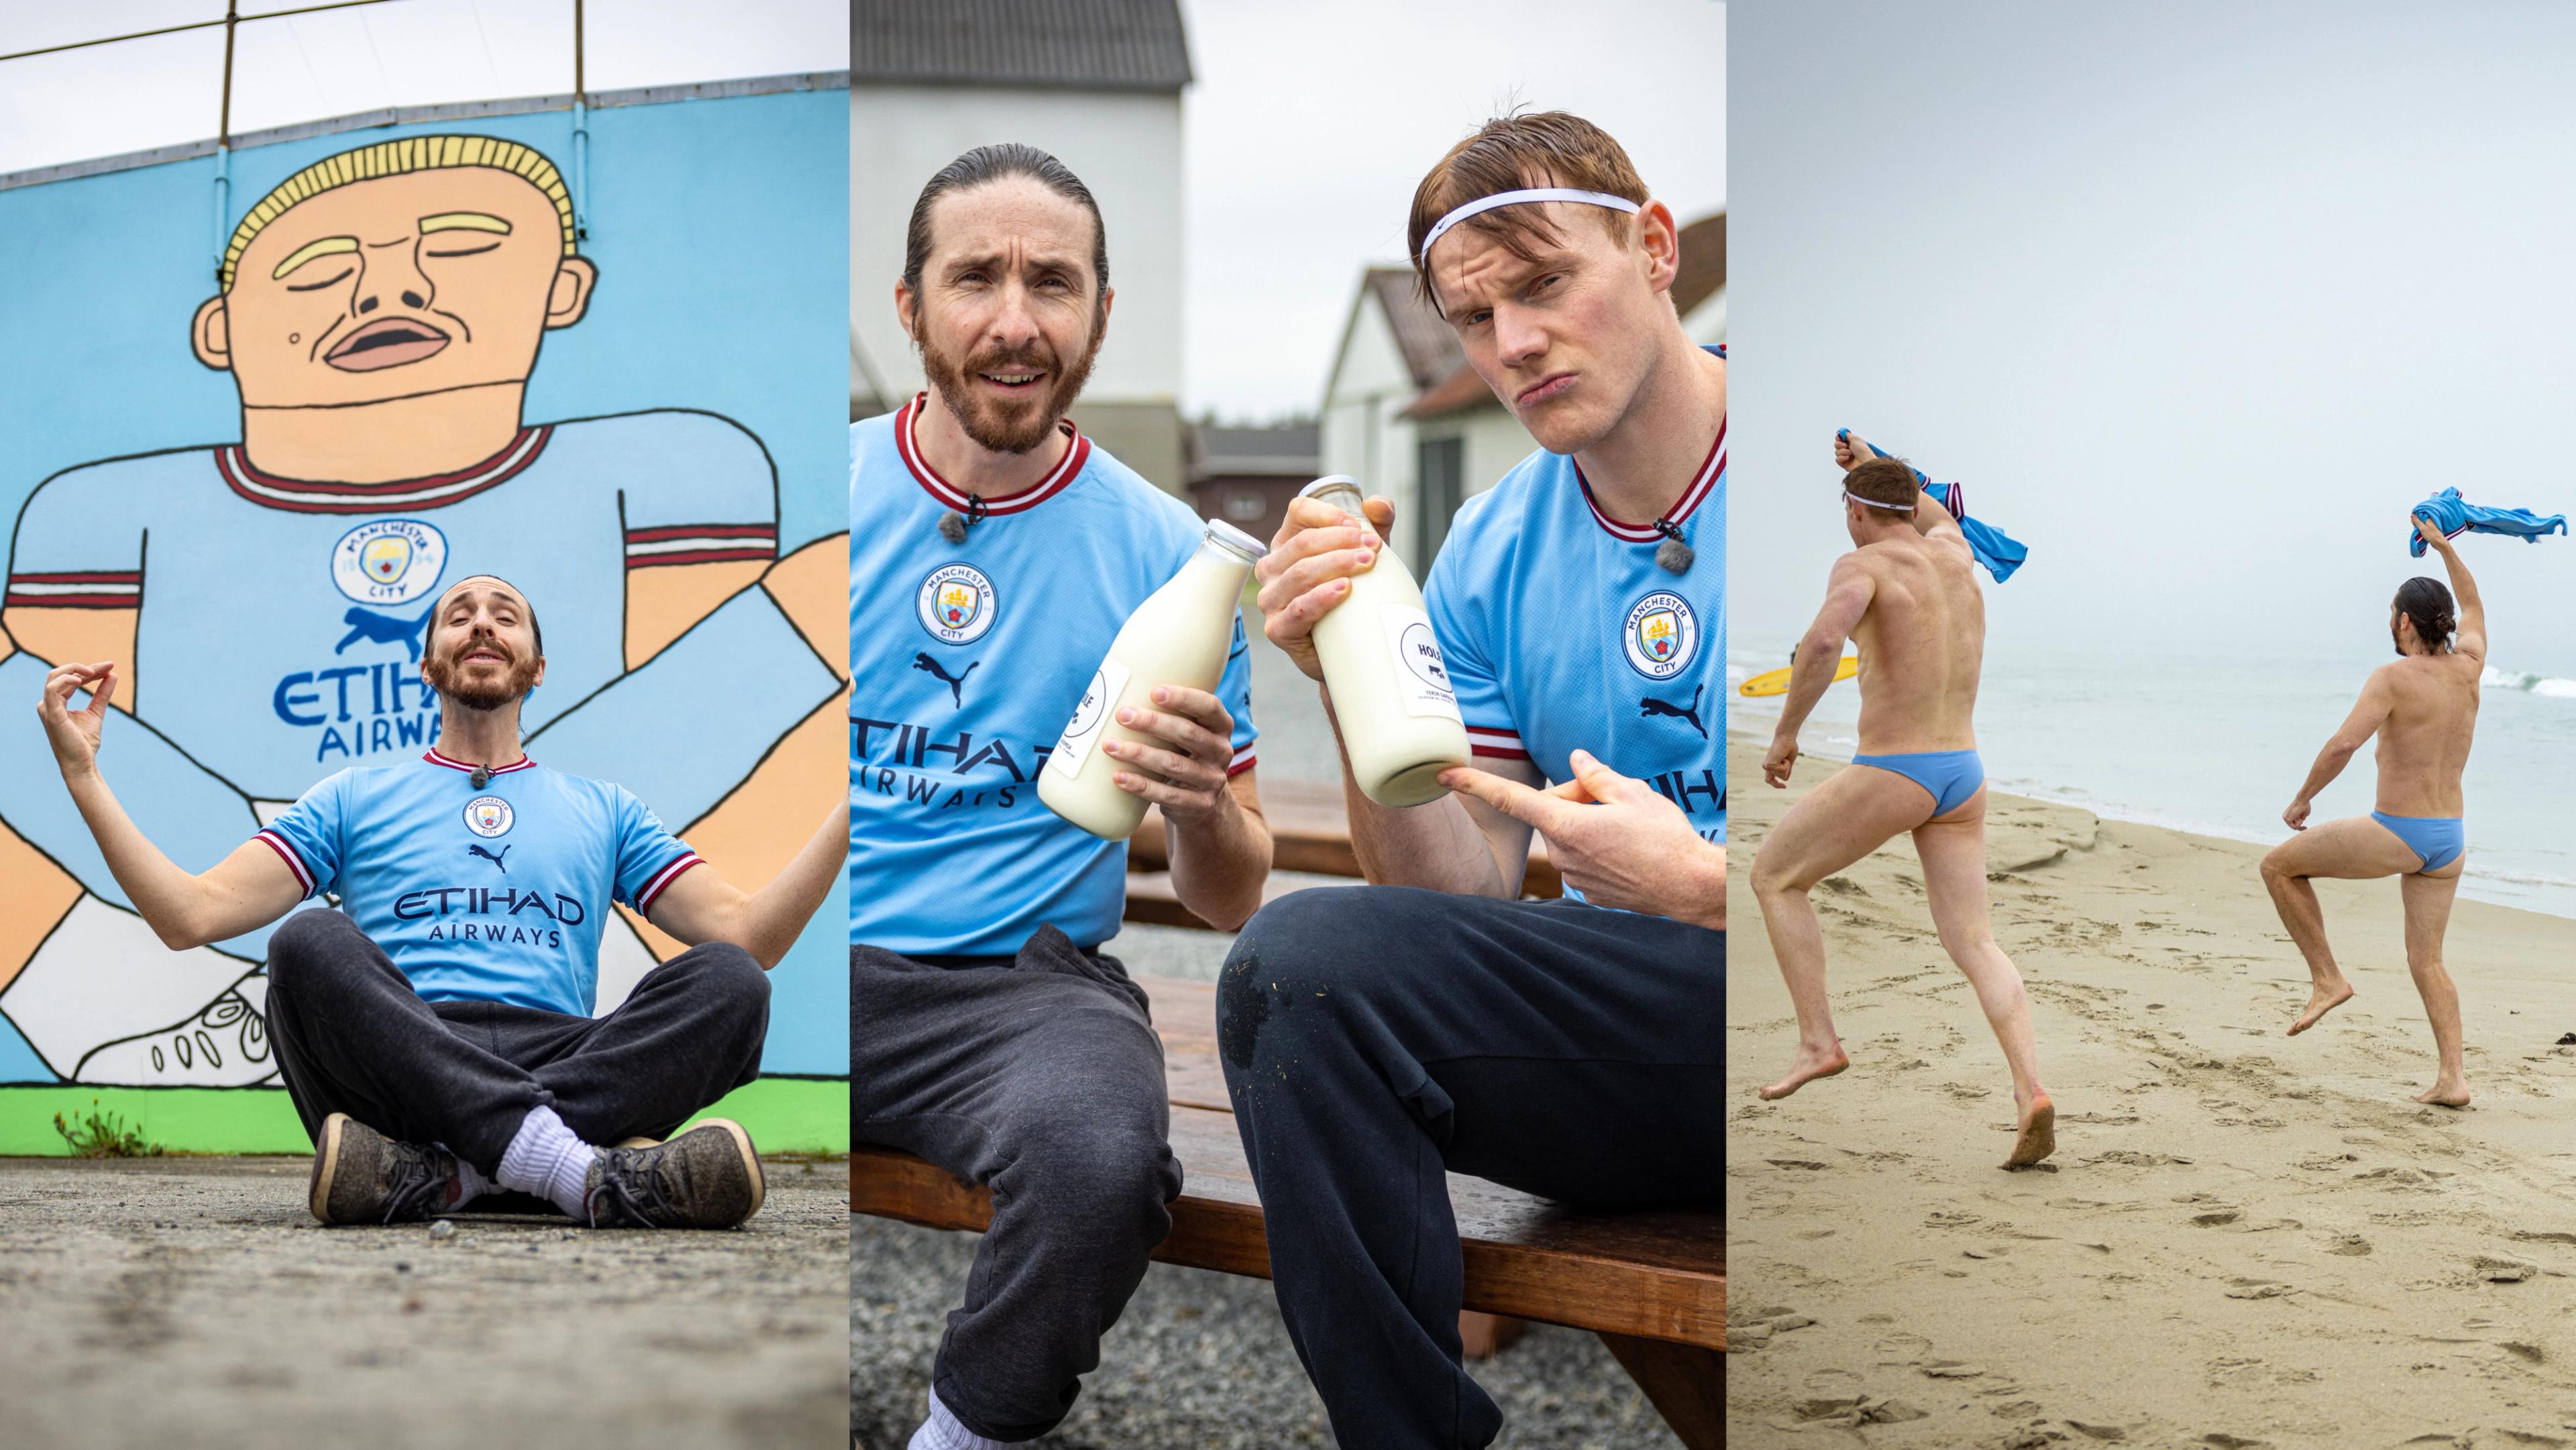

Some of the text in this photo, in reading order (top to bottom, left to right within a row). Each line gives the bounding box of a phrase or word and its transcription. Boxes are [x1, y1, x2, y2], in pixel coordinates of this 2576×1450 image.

[347, 523, 428, 552] MANCHESTER
[370, 584, 407, 597] CITY
[928, 568, 991, 599] MANCHESTER
[1628, 597, 1687, 630] MANCHESTER
[941, 629, 964, 639] CITY
[1654, 662, 1676, 674] CITY
[273, 662, 440, 726] ETIH
[468, 798, 509, 811] MANCHESTER
[394, 888, 584, 926] ETIHAD
[429, 923, 560, 948] AIRWAYS
